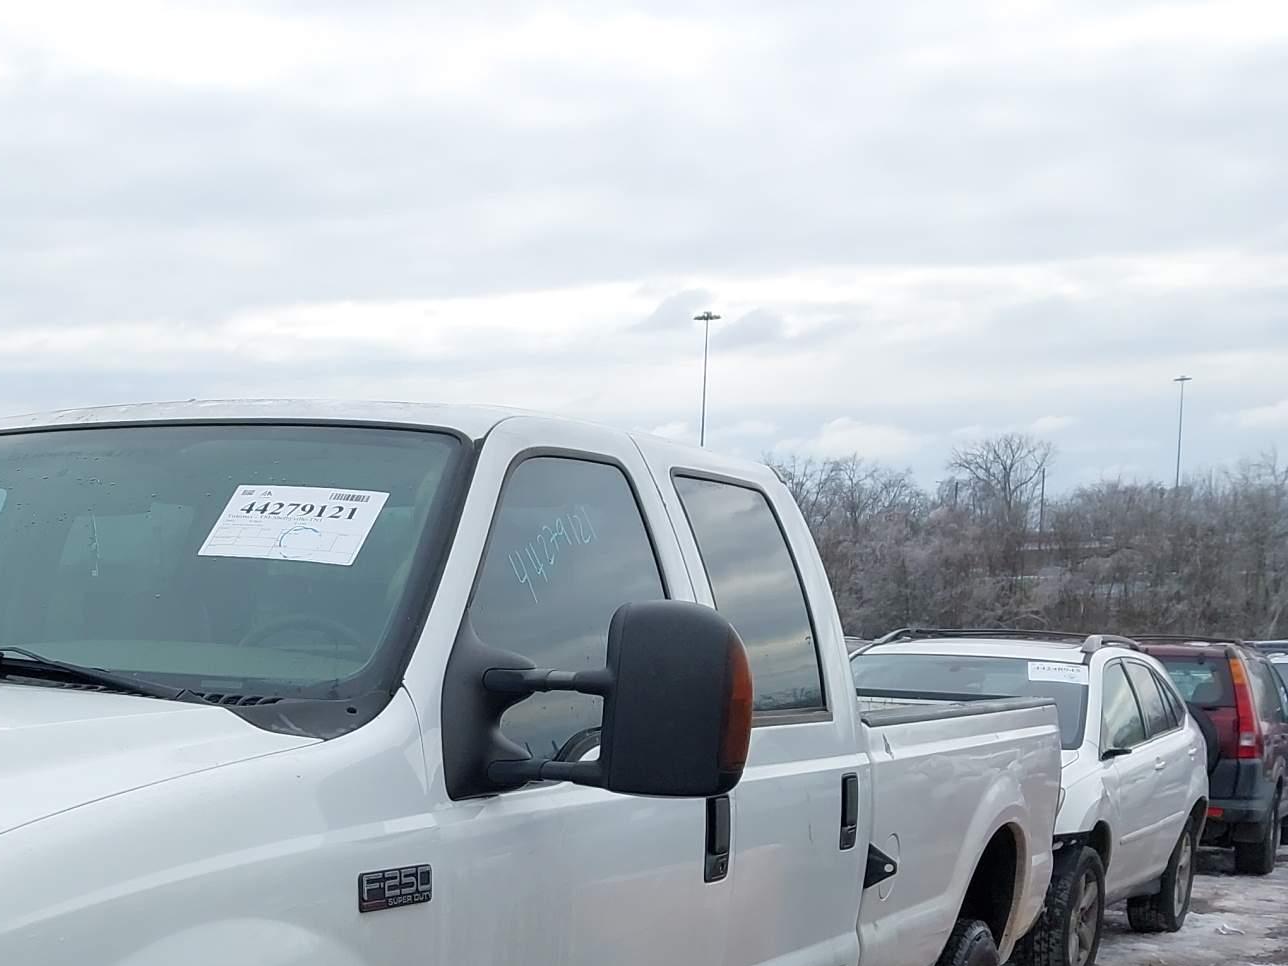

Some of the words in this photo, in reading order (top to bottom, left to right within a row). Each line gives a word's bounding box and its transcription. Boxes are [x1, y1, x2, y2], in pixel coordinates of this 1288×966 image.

[240, 501, 359, 520] 44279121
[509, 505, 597, 603] 44279121
[388, 895, 412, 906] SUPER
